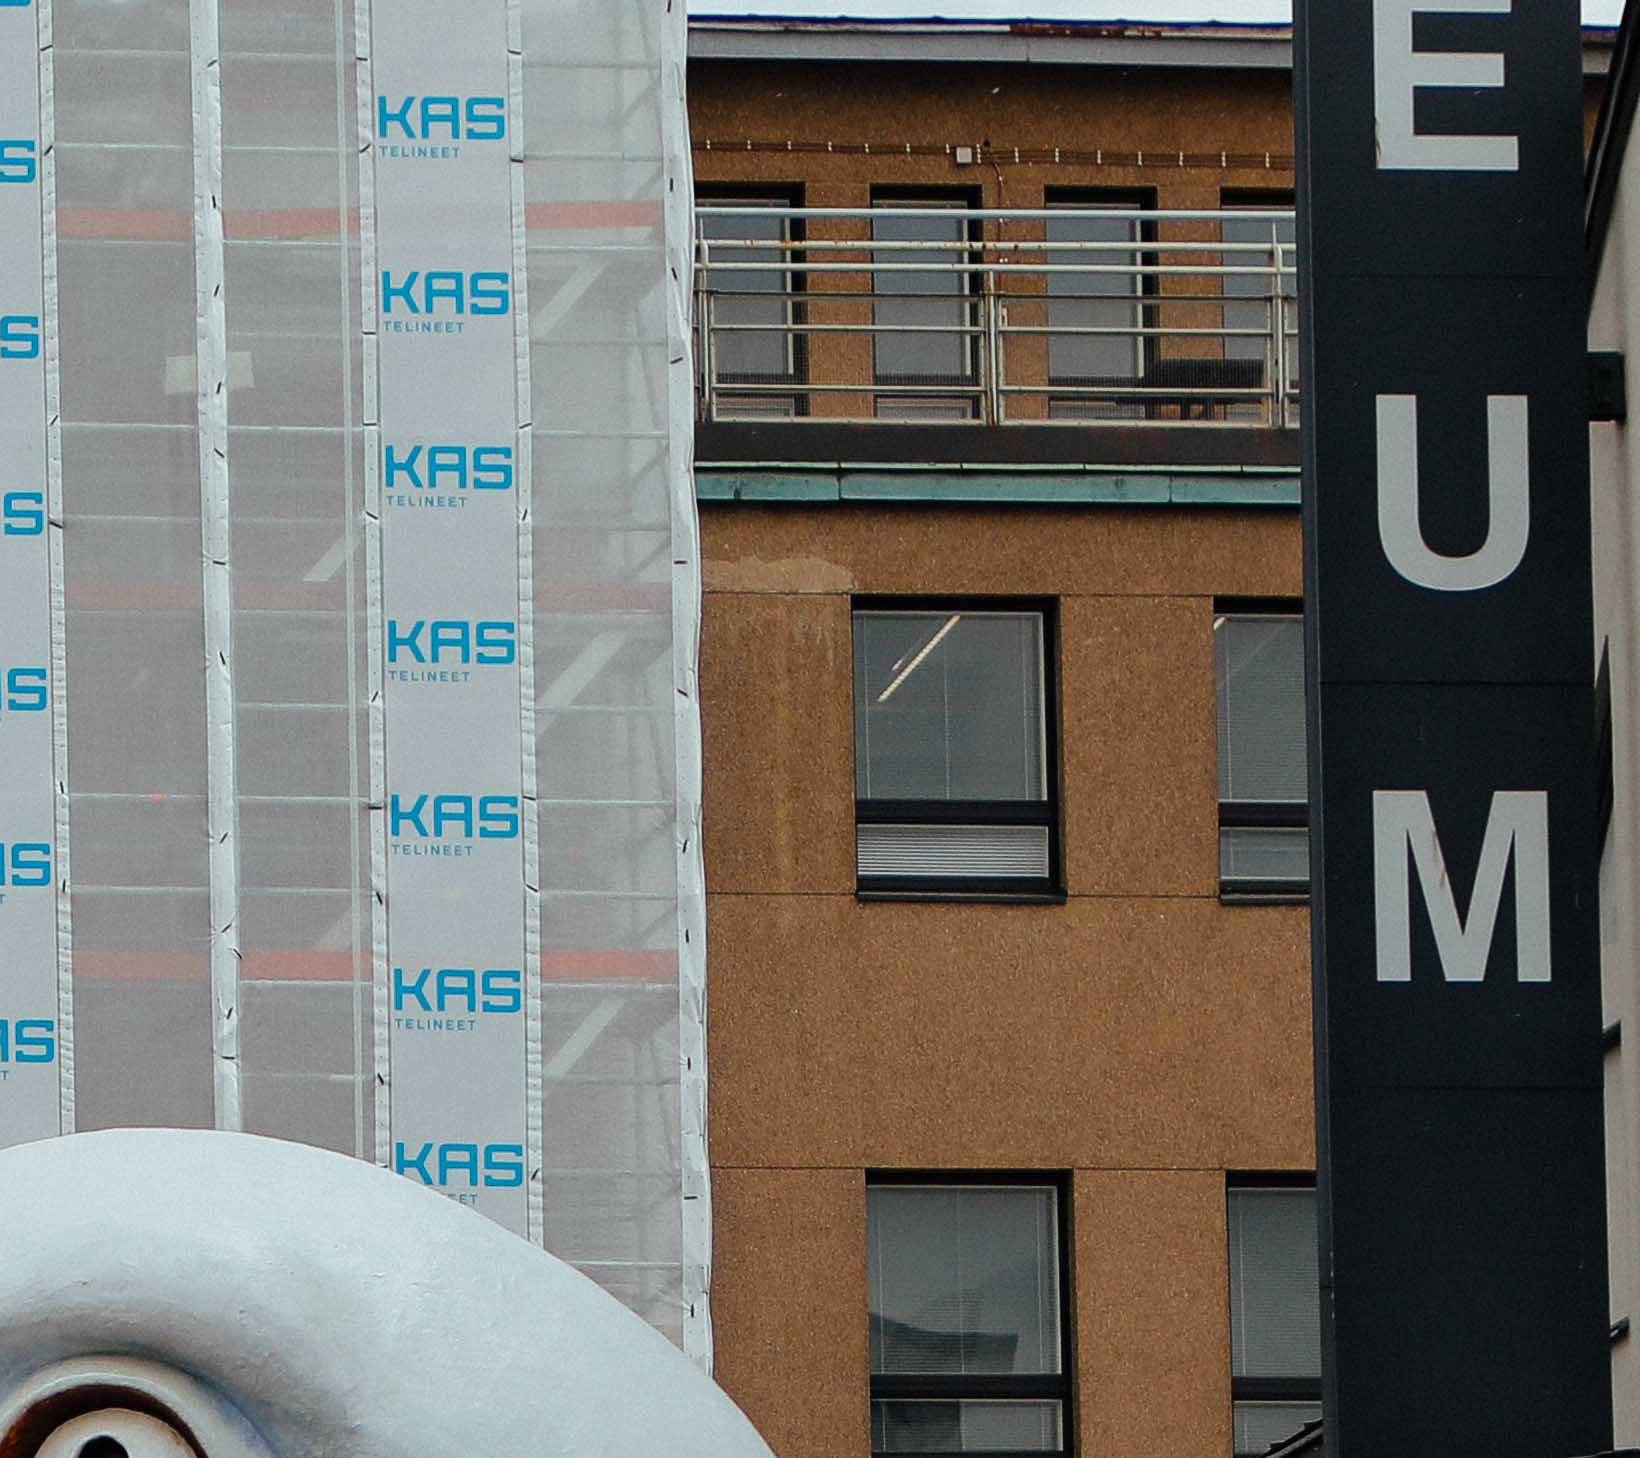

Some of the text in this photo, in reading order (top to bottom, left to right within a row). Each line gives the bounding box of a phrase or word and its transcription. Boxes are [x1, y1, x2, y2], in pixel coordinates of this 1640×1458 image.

[379, 96, 505, 140] KAS
[380, 144, 461, 159] TELINEET
[383, 272, 509, 315] KAS
[384, 319, 465, 334] TELINEET
[386, 445, 512, 489] KAS
[387, 493, 468, 508] TELINEET
[388, 620, 515, 664] KAS
[389, 668, 470, 683] TELINEET
[391, 794, 519, 838] KAS
[392, 842, 473, 857] TELINEET
[394, 968, 521, 1013] KAS
[395, 1017, 476, 1032] TELINEET
[396, 1142, 523, 1187] KAS
